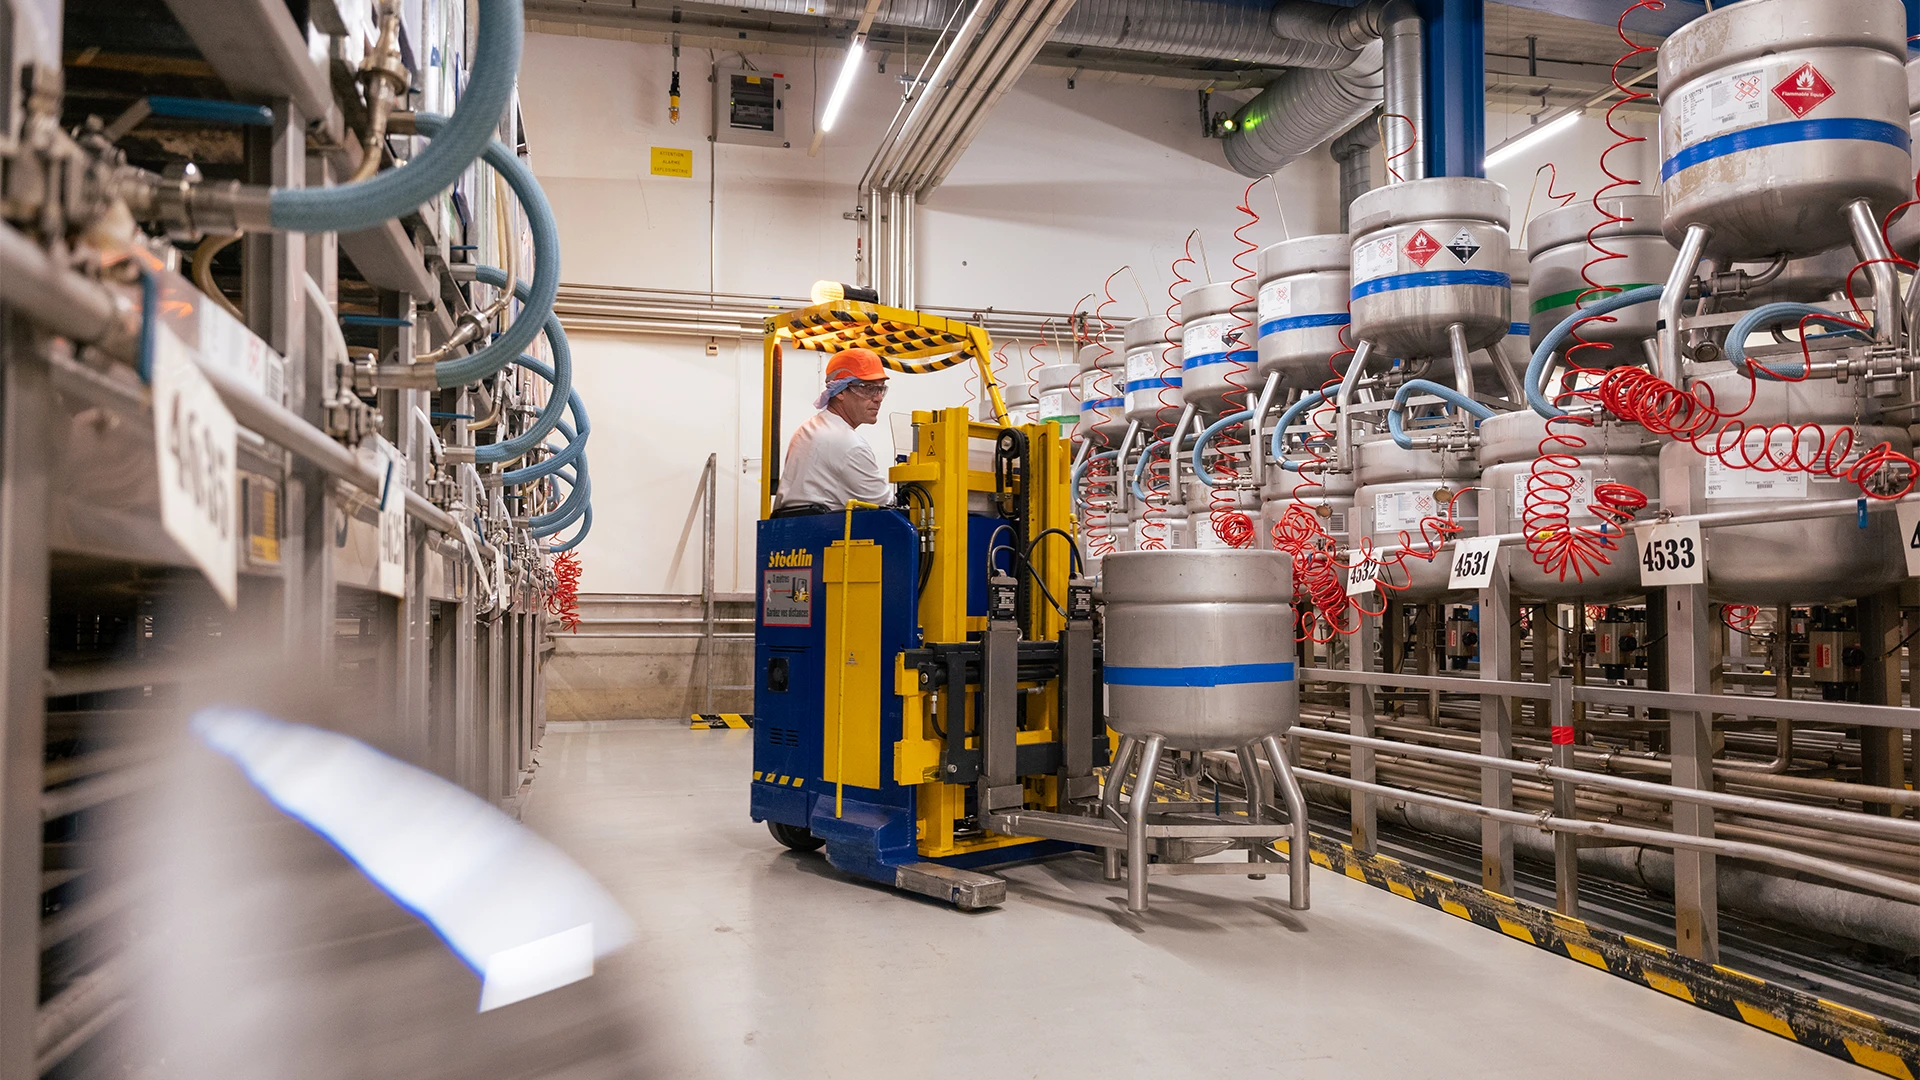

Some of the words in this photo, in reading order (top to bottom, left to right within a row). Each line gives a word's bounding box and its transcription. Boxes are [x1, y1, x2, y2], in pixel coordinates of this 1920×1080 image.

[764, 322, 775, 334] 33
[1454, 550, 1490, 577] 4531
[1642, 537, 1695, 572] 4533
[1350, 558, 1377, 584] 4532
[766, 607, 780, 617] Gardez
[789, 607, 809, 617] distances
